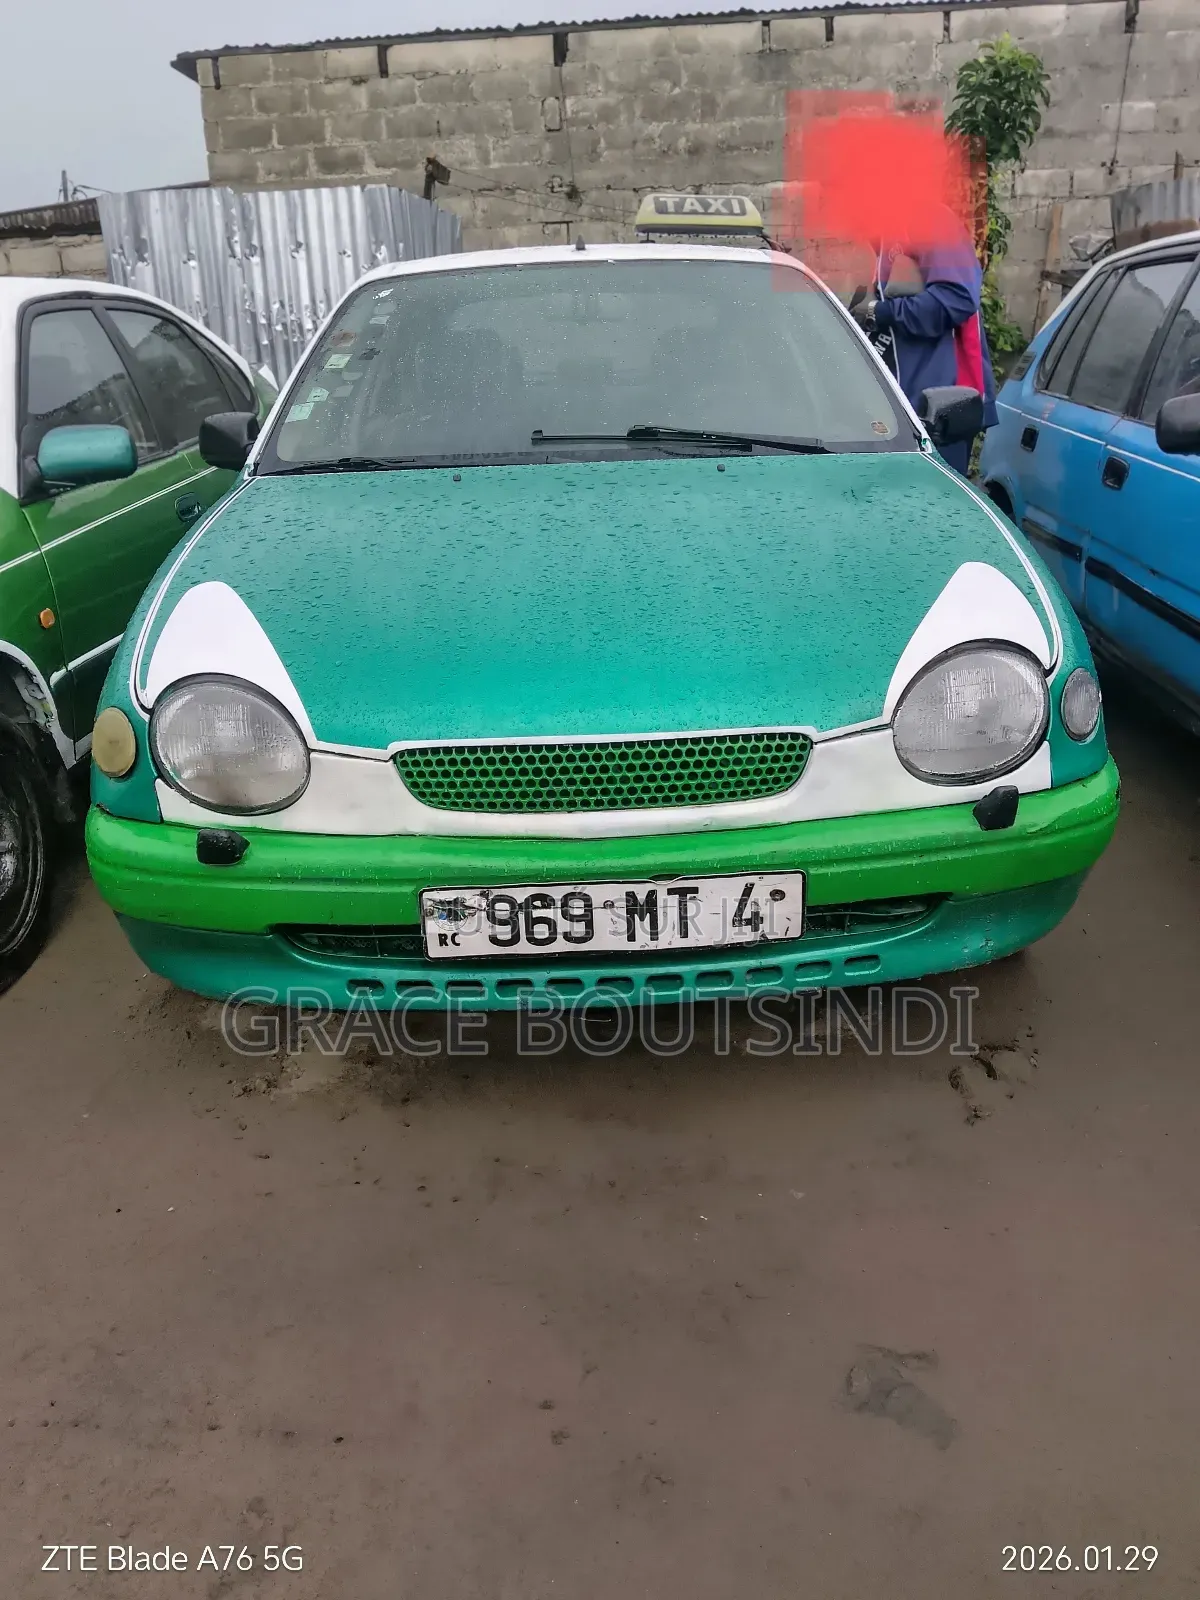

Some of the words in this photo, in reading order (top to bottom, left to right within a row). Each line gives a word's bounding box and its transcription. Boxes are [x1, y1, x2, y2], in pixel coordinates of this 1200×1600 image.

[659, 197, 741, 214] TAXI
[486, 891, 595, 947] 969
[625, 886, 699, 943] MT
[732, 882, 764, 933] 4
[437, 932, 462, 948] RC
